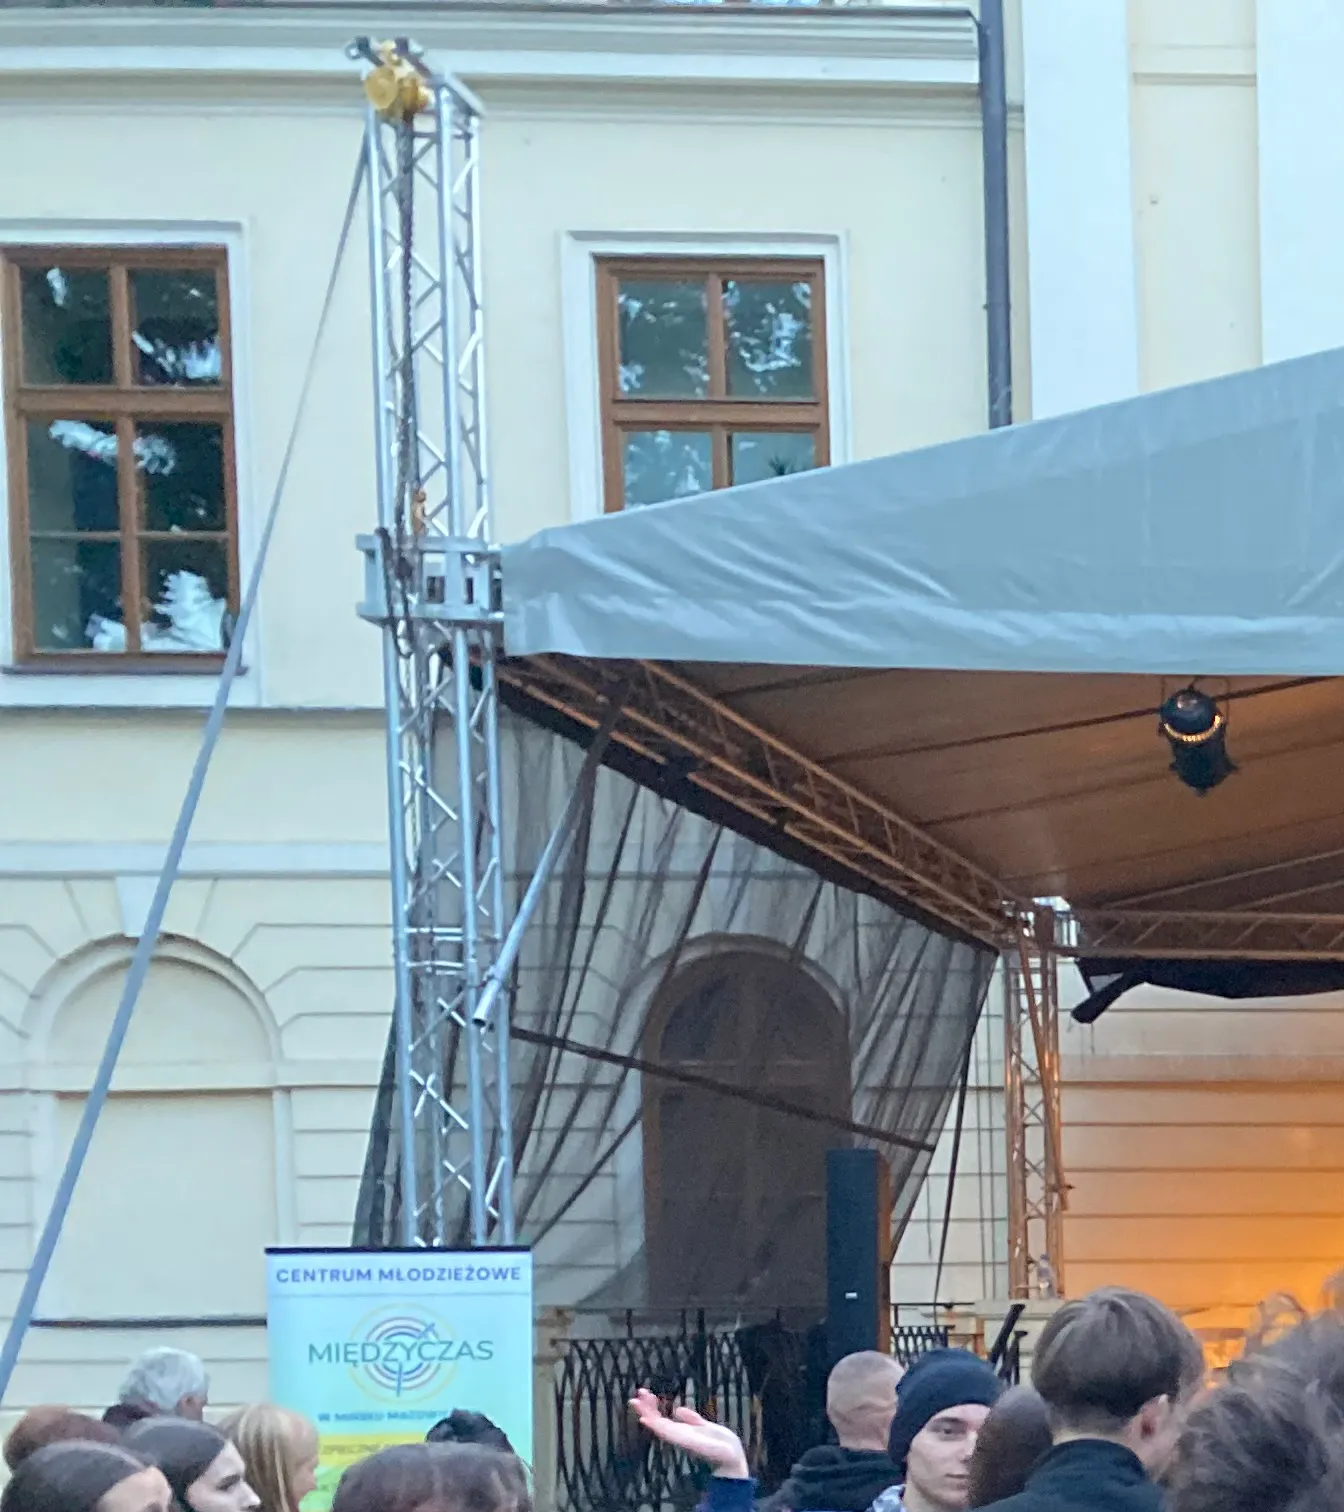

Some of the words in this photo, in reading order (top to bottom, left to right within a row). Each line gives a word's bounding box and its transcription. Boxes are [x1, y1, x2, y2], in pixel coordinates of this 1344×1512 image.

[276, 1268, 372, 1283] CENTRUM
[378, 1264, 521, 1283] MŁODZIEŻOWE
[308, 1340, 494, 1367] MIĘDZYCZAS
